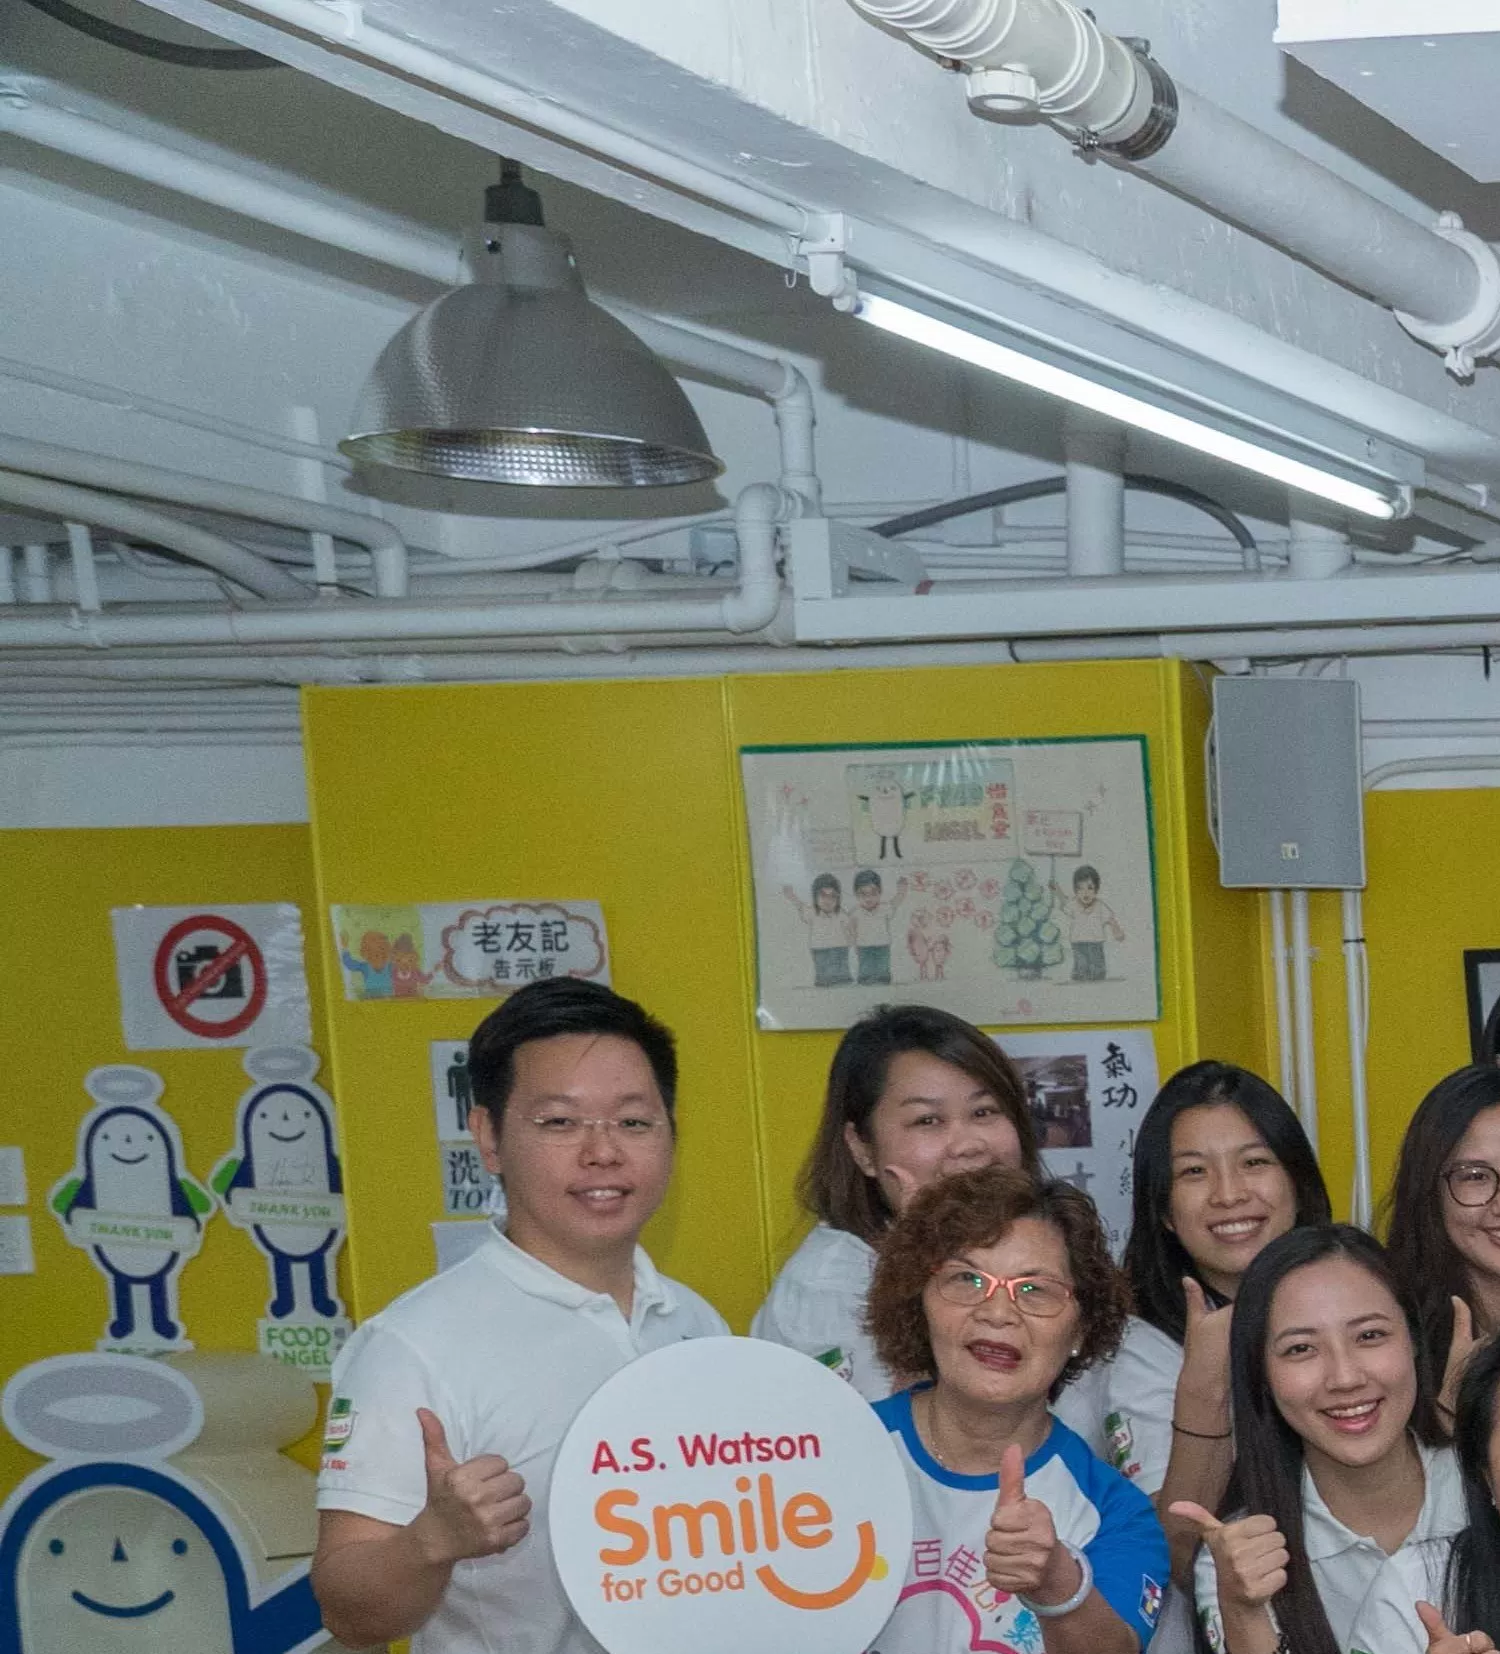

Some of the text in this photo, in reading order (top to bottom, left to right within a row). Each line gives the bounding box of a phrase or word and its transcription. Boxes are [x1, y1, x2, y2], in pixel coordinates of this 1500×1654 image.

[472, 919, 571, 954] 老友記
[266, 1326, 331, 1348] FOOD
[591, 1431, 822, 1475] A.S. Watson
[593, 1472, 834, 1566] Smile
[600, 1560, 746, 1603] for Good
